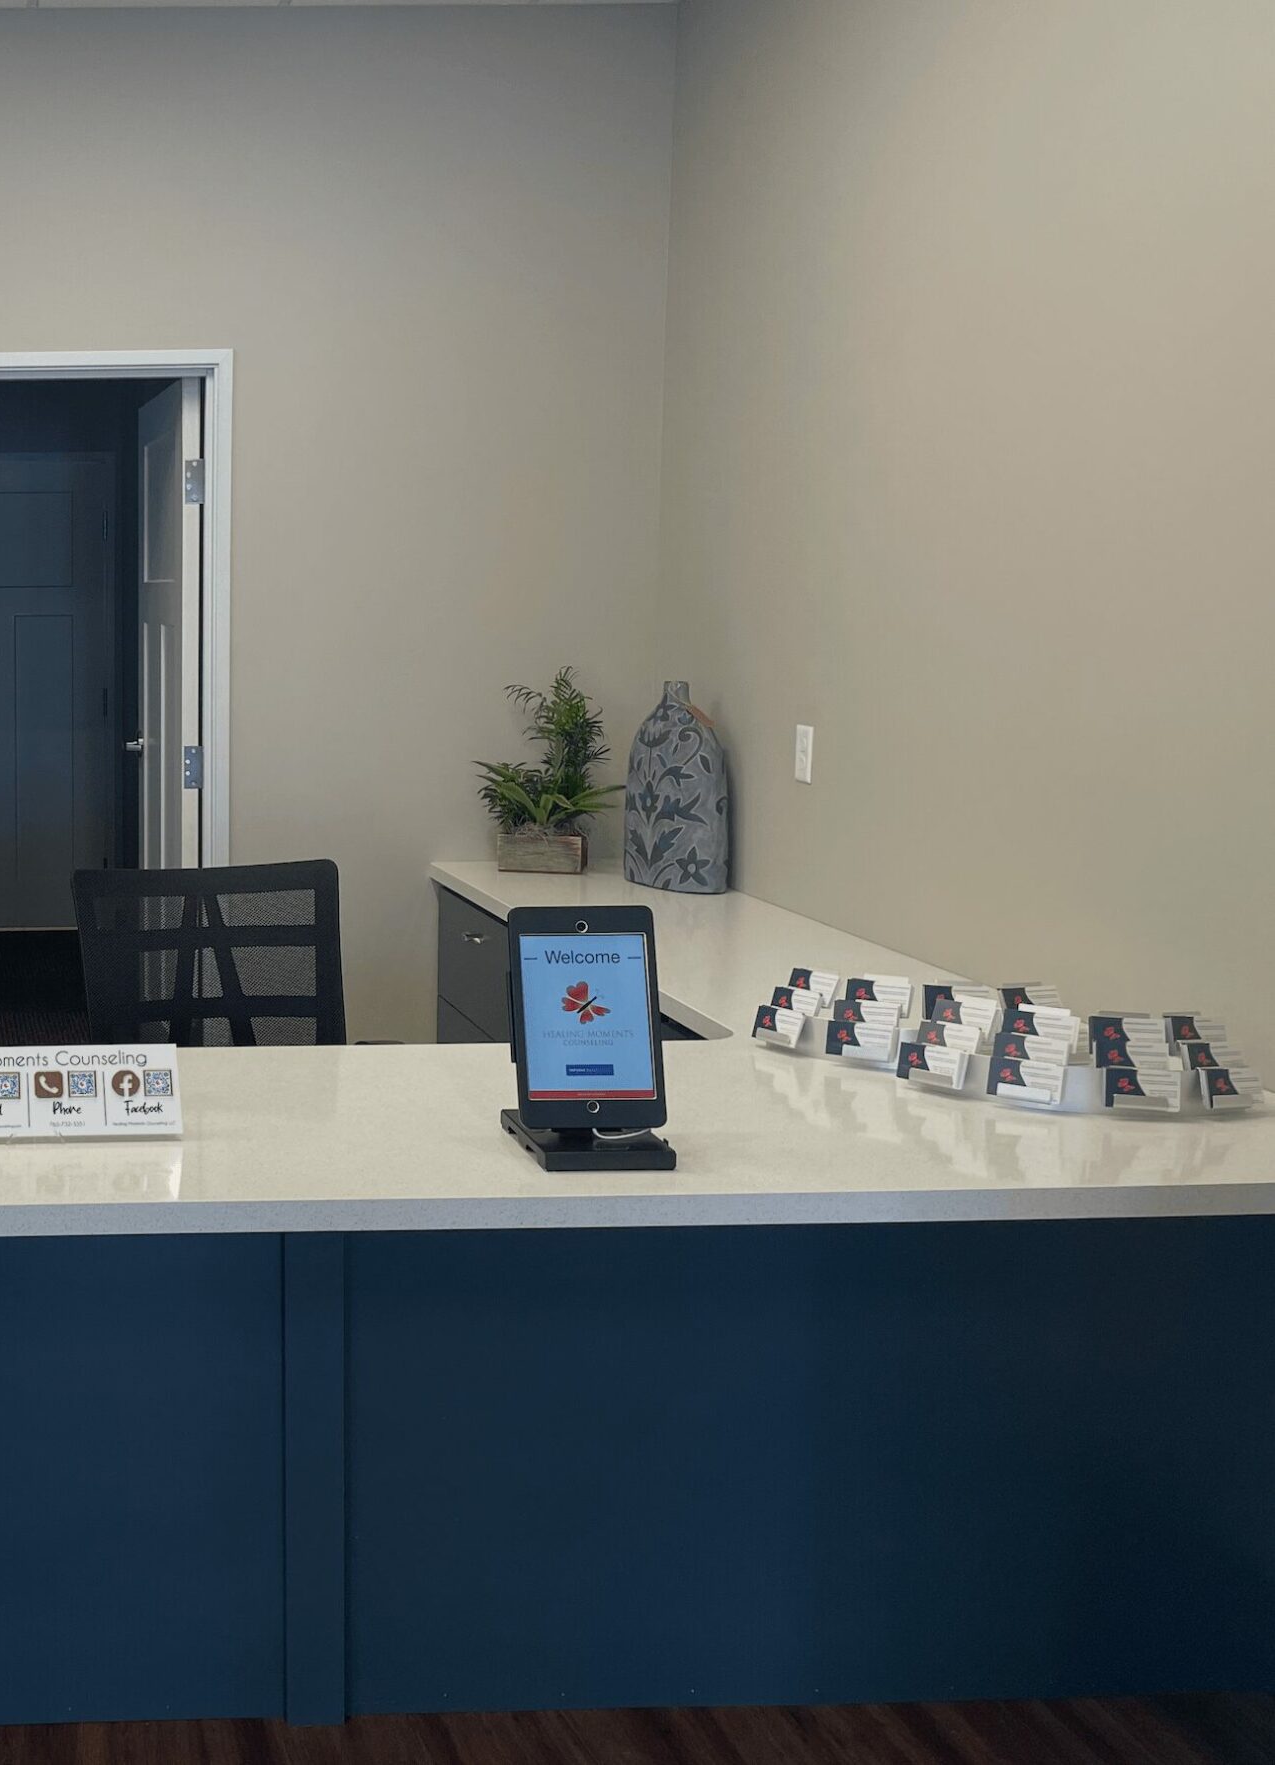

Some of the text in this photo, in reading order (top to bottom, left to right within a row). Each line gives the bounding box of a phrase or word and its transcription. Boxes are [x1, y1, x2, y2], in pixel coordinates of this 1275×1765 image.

[544, 949, 621, 965] Welcome
[54, 1050, 148, 1068] Counseling
[51, 1101, 83, 1115] Phone
[123, 1100, 164, 1116] Facebook
